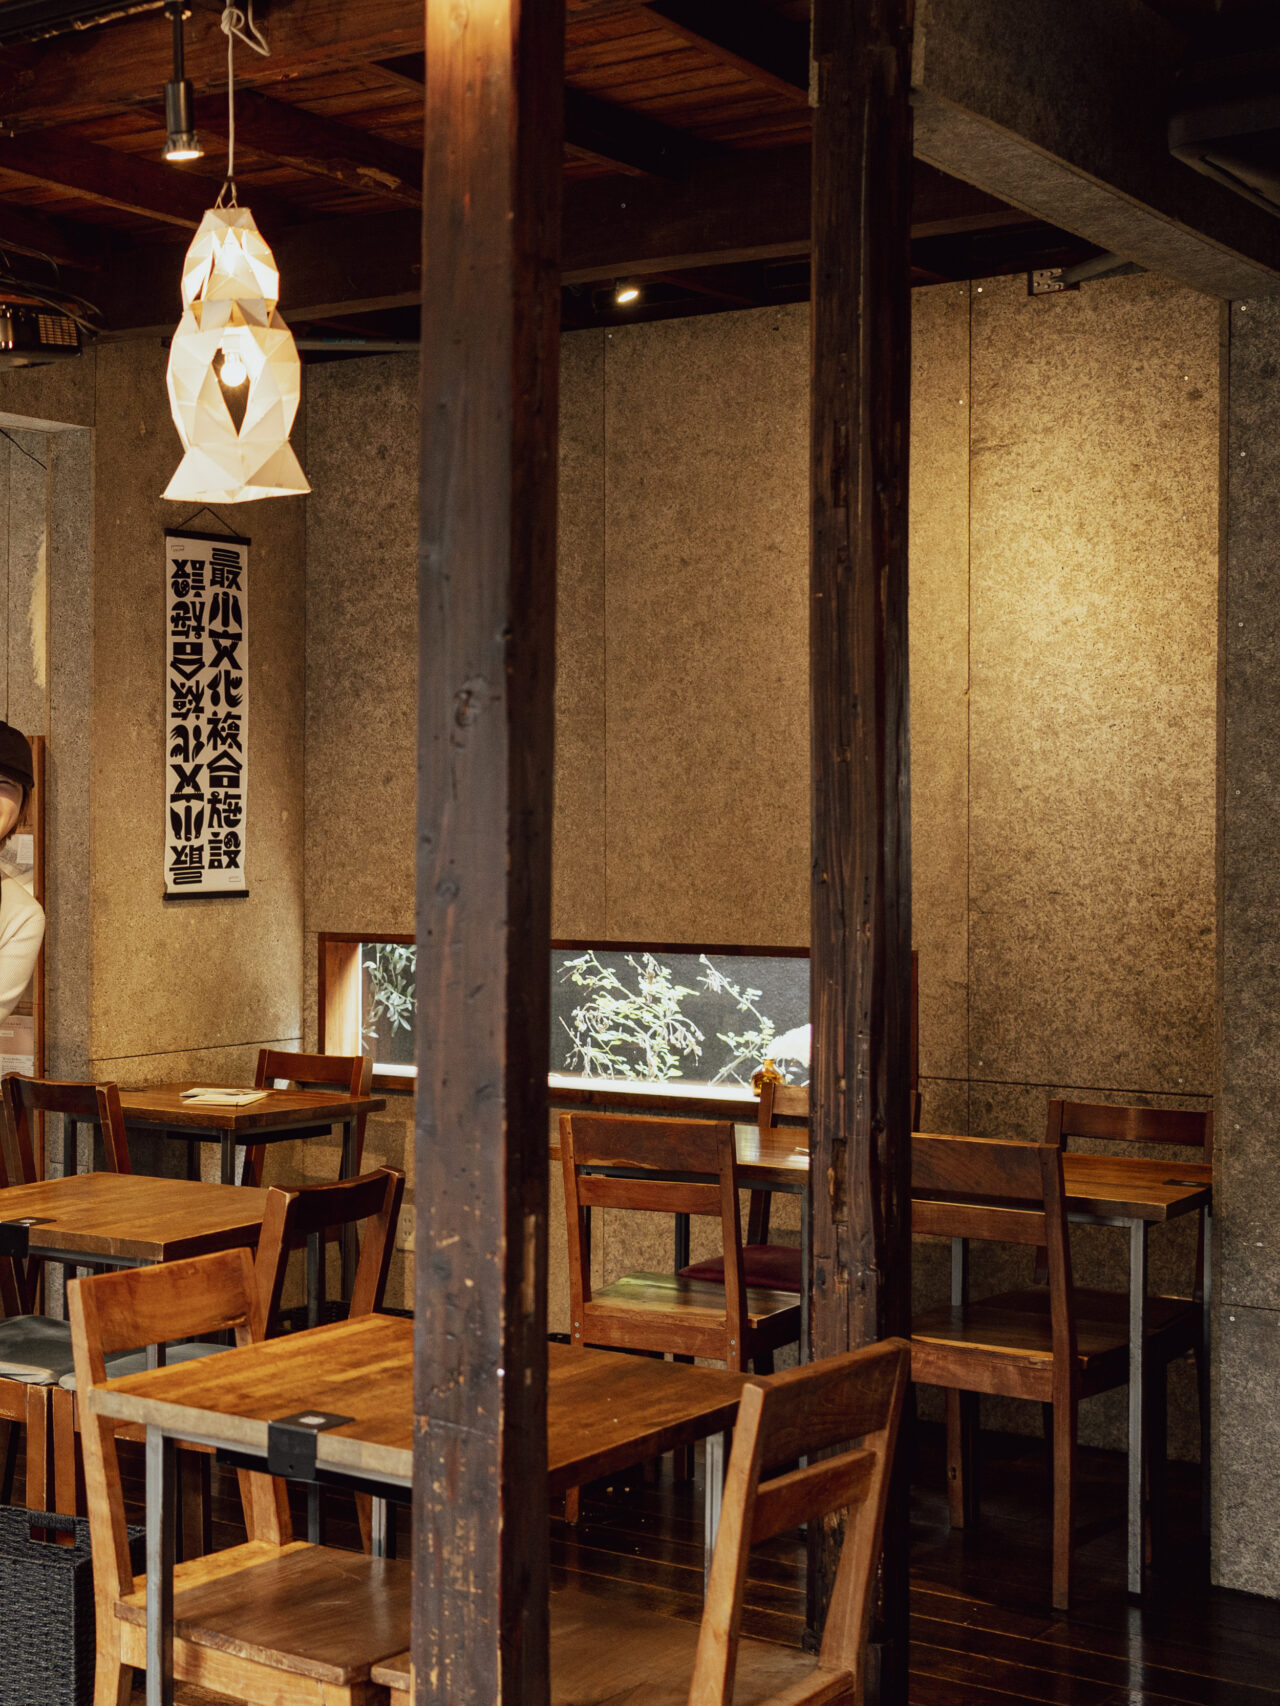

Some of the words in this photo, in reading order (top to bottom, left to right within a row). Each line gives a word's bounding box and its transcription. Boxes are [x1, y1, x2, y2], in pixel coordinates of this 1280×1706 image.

[206, 547, 243, 869] 最小文化複合施設
